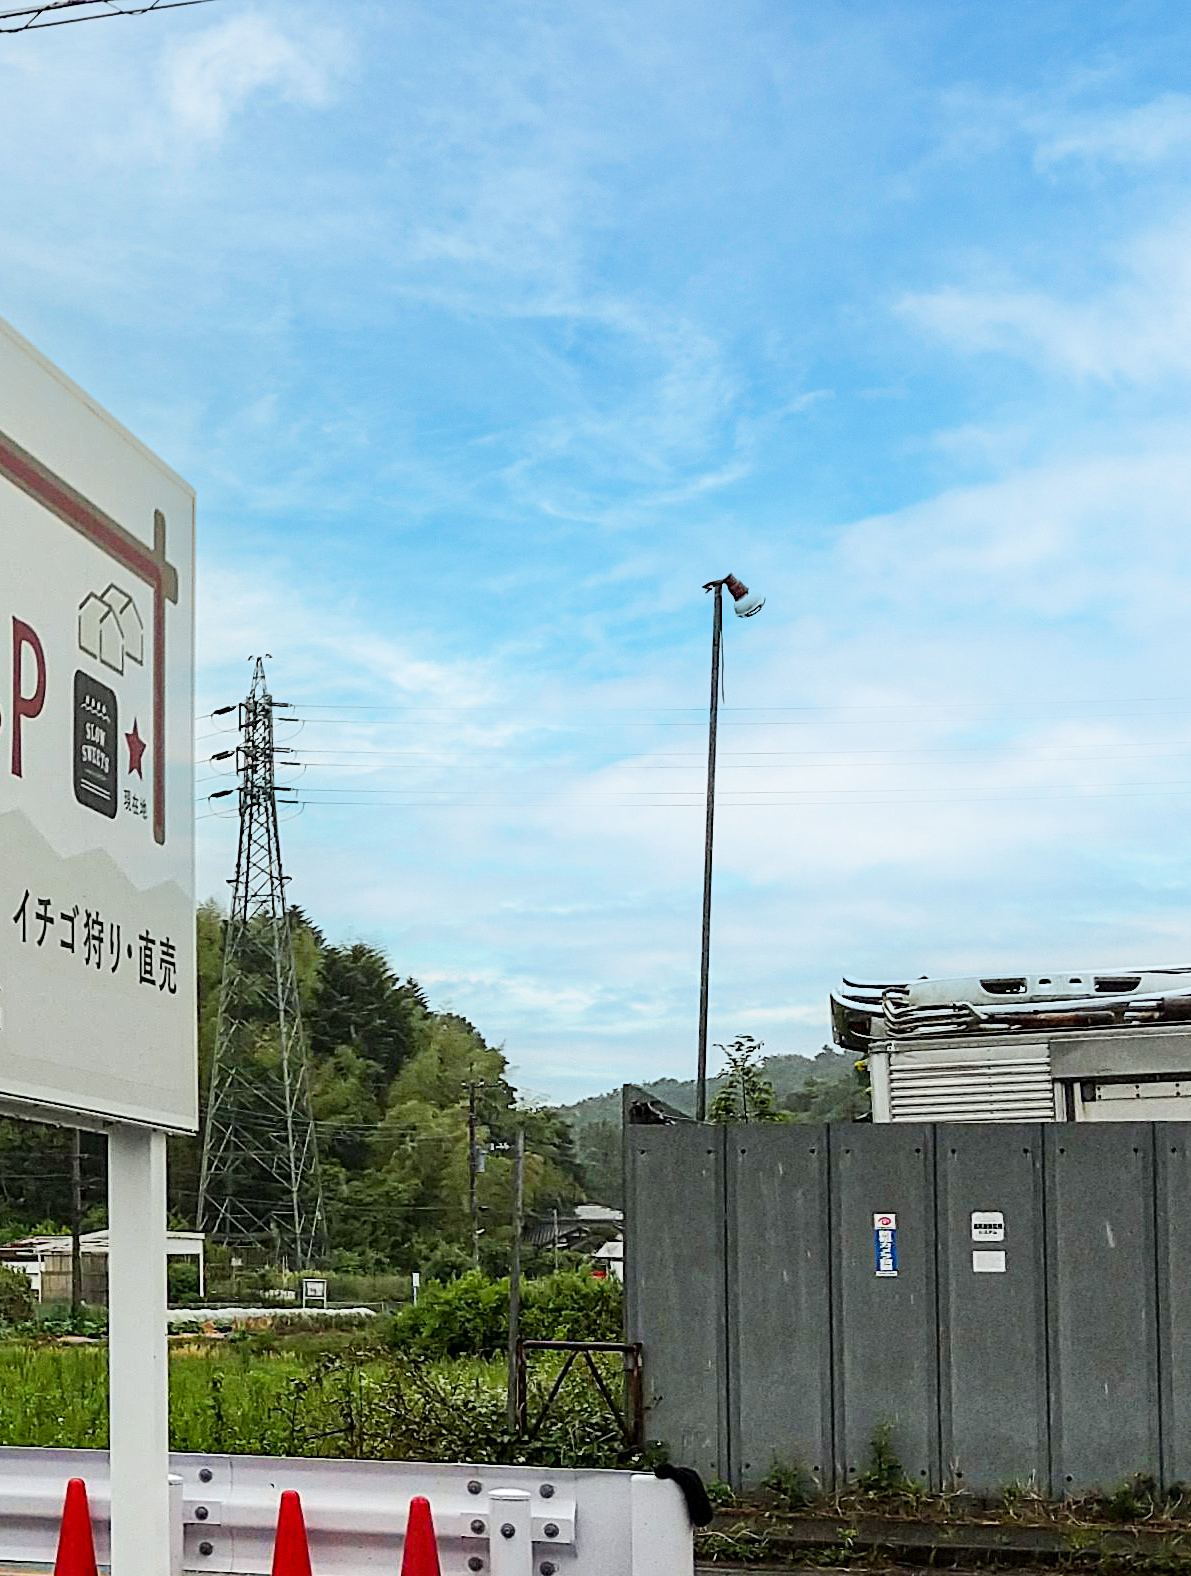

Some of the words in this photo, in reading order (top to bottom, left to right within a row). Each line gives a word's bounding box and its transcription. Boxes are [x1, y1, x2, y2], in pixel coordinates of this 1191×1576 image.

[11, 615, 47, 778] P
[81, 744, 110, 774] SWEETS
[85, 722, 107, 747] SLOW
[13, 888, 177, 994] イチゴ狩り・直売
